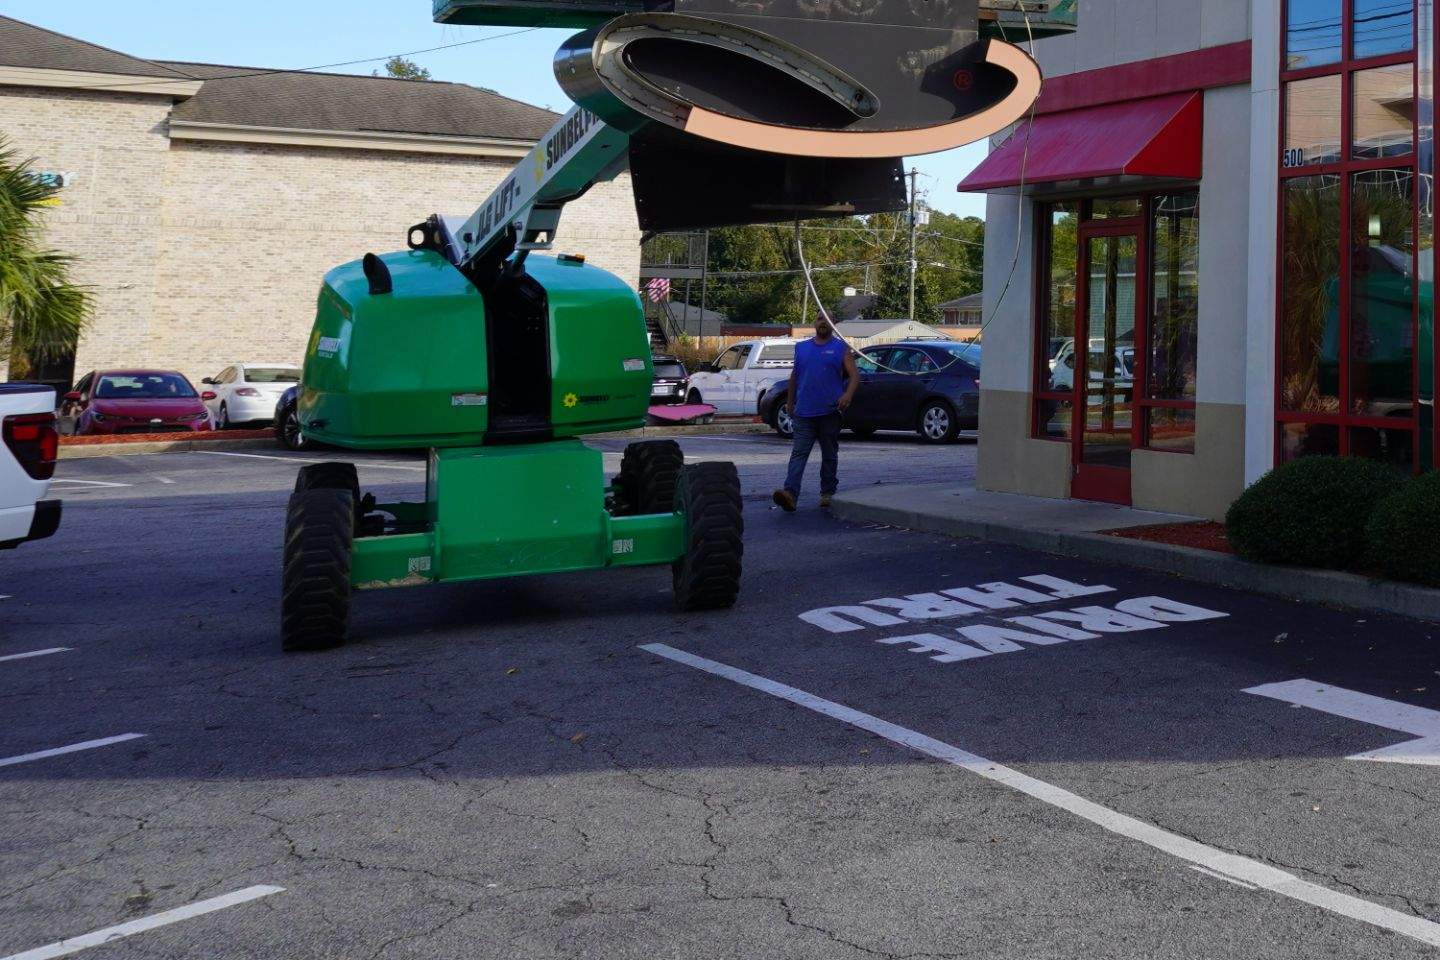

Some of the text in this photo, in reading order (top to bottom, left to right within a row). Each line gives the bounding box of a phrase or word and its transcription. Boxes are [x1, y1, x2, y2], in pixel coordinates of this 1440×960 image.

[1284, 148, 1303, 167] 500
[494, 176, 516, 227] LIFT
[798, 573, 1117, 633] THRU
[875, 595, 1230, 663] DRIVE
